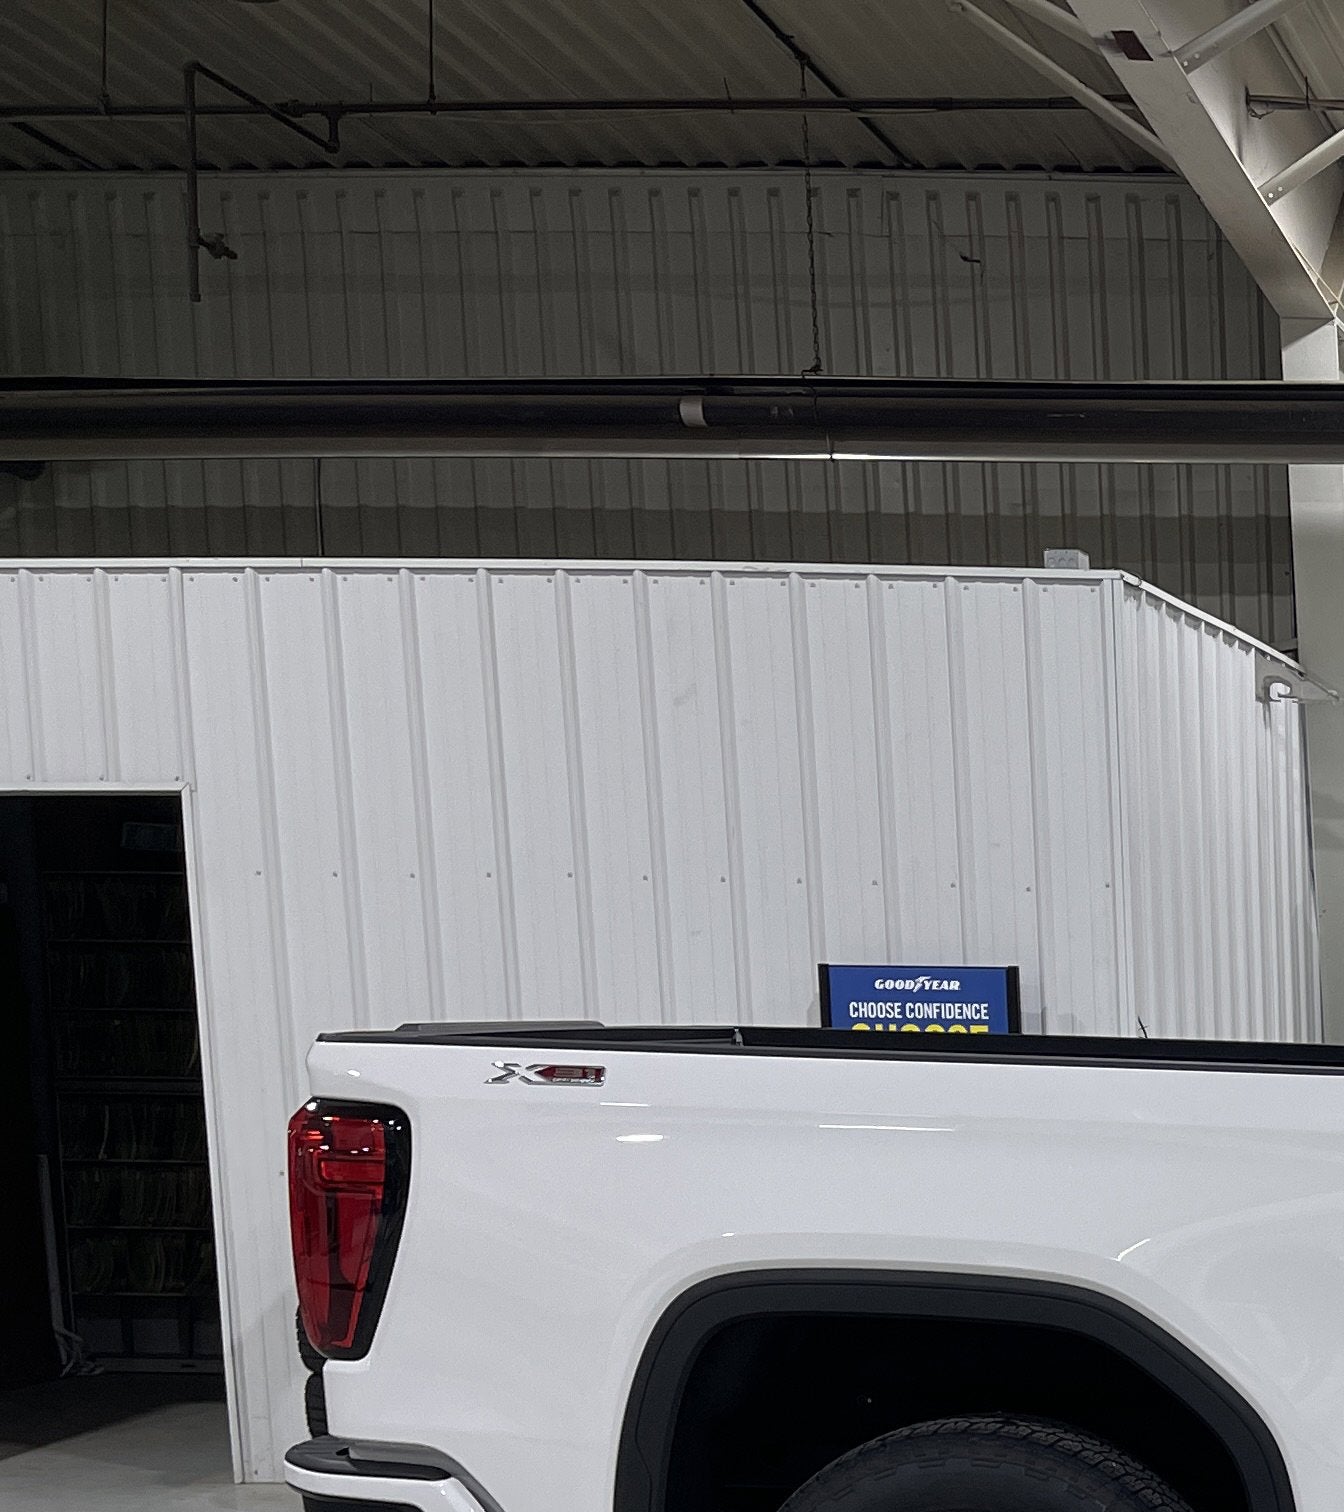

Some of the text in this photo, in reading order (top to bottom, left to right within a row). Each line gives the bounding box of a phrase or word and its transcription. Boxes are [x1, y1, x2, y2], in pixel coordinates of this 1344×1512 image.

[875, 976, 960, 992] GOODYEAR
[849, 1002, 989, 1020] CHOOSE CONFIDENCE
